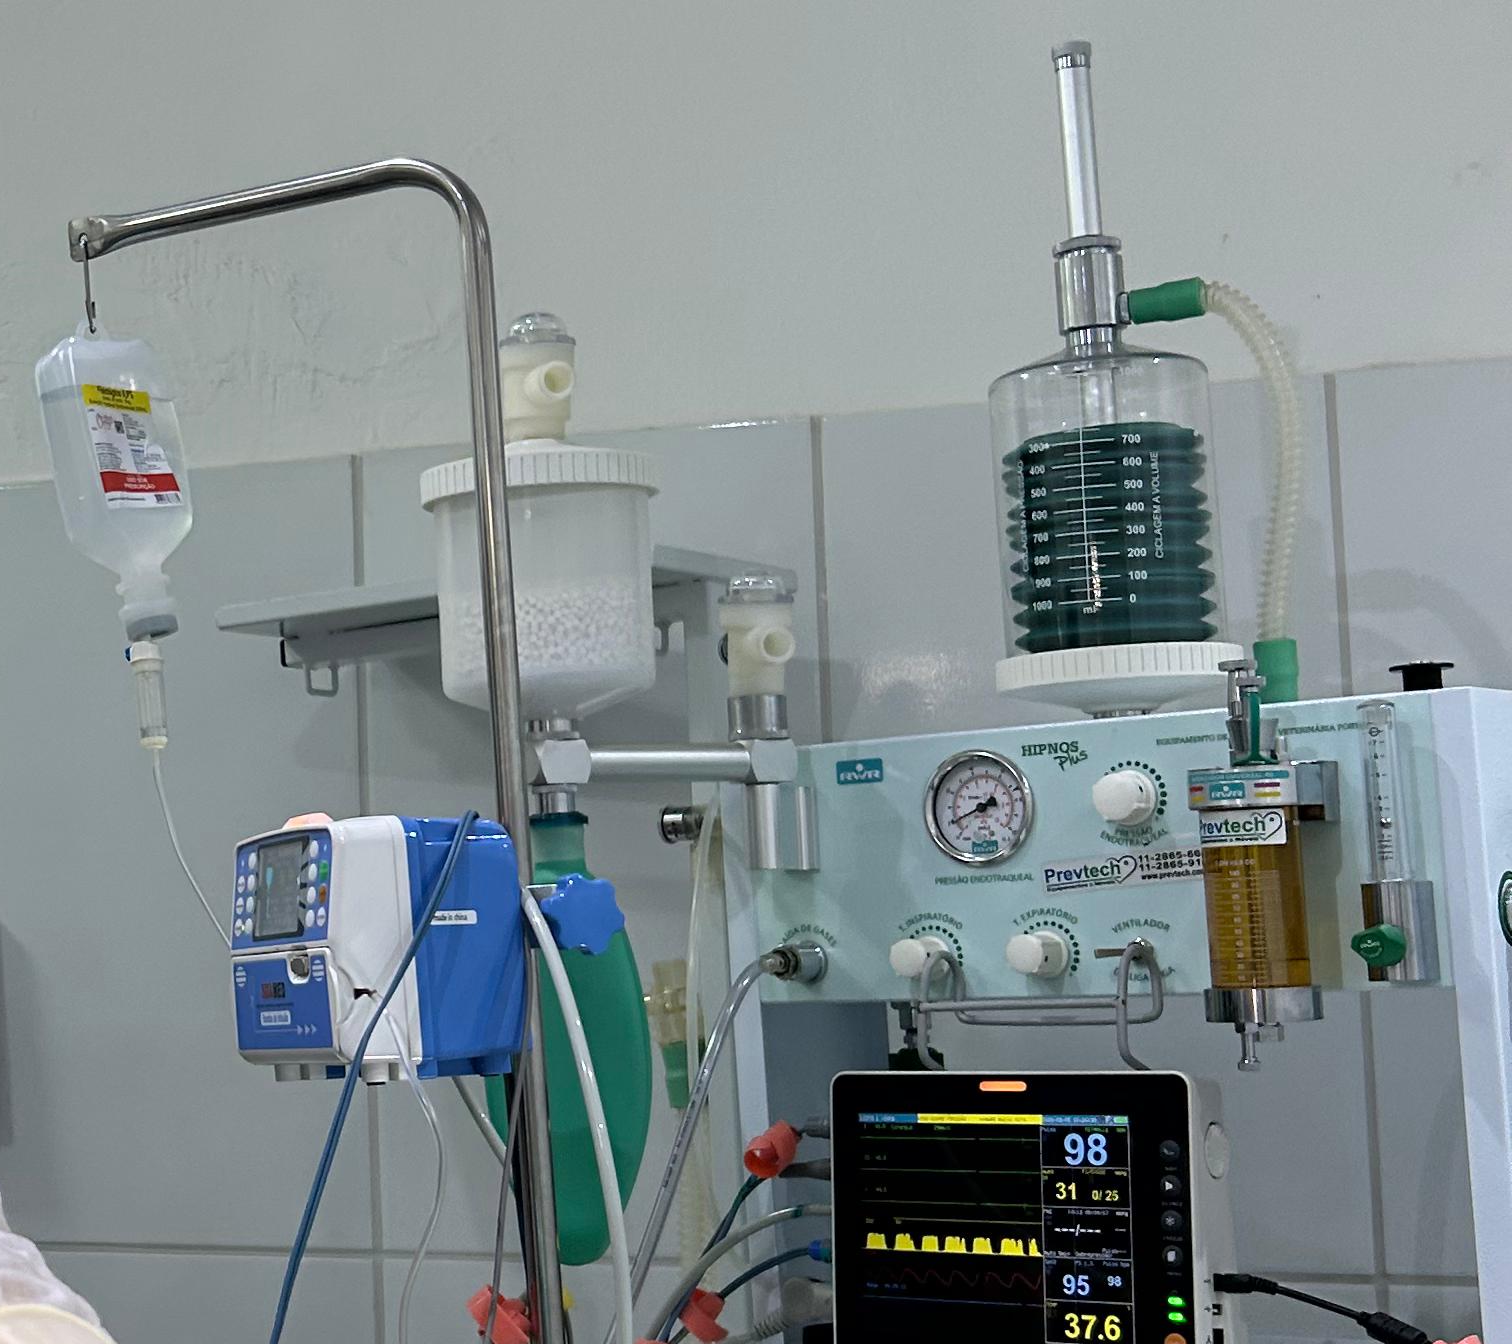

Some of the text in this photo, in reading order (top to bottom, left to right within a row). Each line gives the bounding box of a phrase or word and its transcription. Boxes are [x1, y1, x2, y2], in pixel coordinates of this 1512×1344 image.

[1121, 434, 1141, 444] 700
[1029, 464, 1045, 475] 400
[1123, 479, 1143, 489] 500
[1030, 487, 1046, 498] 500
[1124, 502, 1145, 512] 400
[1149, 451, 1164, 559] CICLAGEM A VOLUME
[1126, 525, 1146, 535] 300
[1033, 532, 1049, 543] 700
[1127, 547, 1147, 557] 200
[1128, 570, 1148, 580] 100
[1129, 594, 1137, 603] 0
[1032, 600, 1053, 611] 1000
[1021, 741, 1080, 757] HIPNOS
[1053, 750, 1089, 771] Plus
[1139, 849, 1202, 862] 11-2865-66
[1044, 861, 1122, 883] Prevtech
[1139, 859, 1202, 872] 11-2865-91
[905, 912, 963, 930] INSPIRATÓRIO
[1020, 907, 1079, 925] EXPIRATÓRIO
[1111, 918, 1171, 934] VENTILADOR
[1063, 1133, 1108, 1166] 98
[1055, 1182, 1077, 1200] 31
[1105, 1190, 1119, 1201] 25
[1062, 1274, 1090, 1296] 95
[1107, 1275, 1122, 1287] 98
[1064, 1312, 1121, 1341] 37.6
